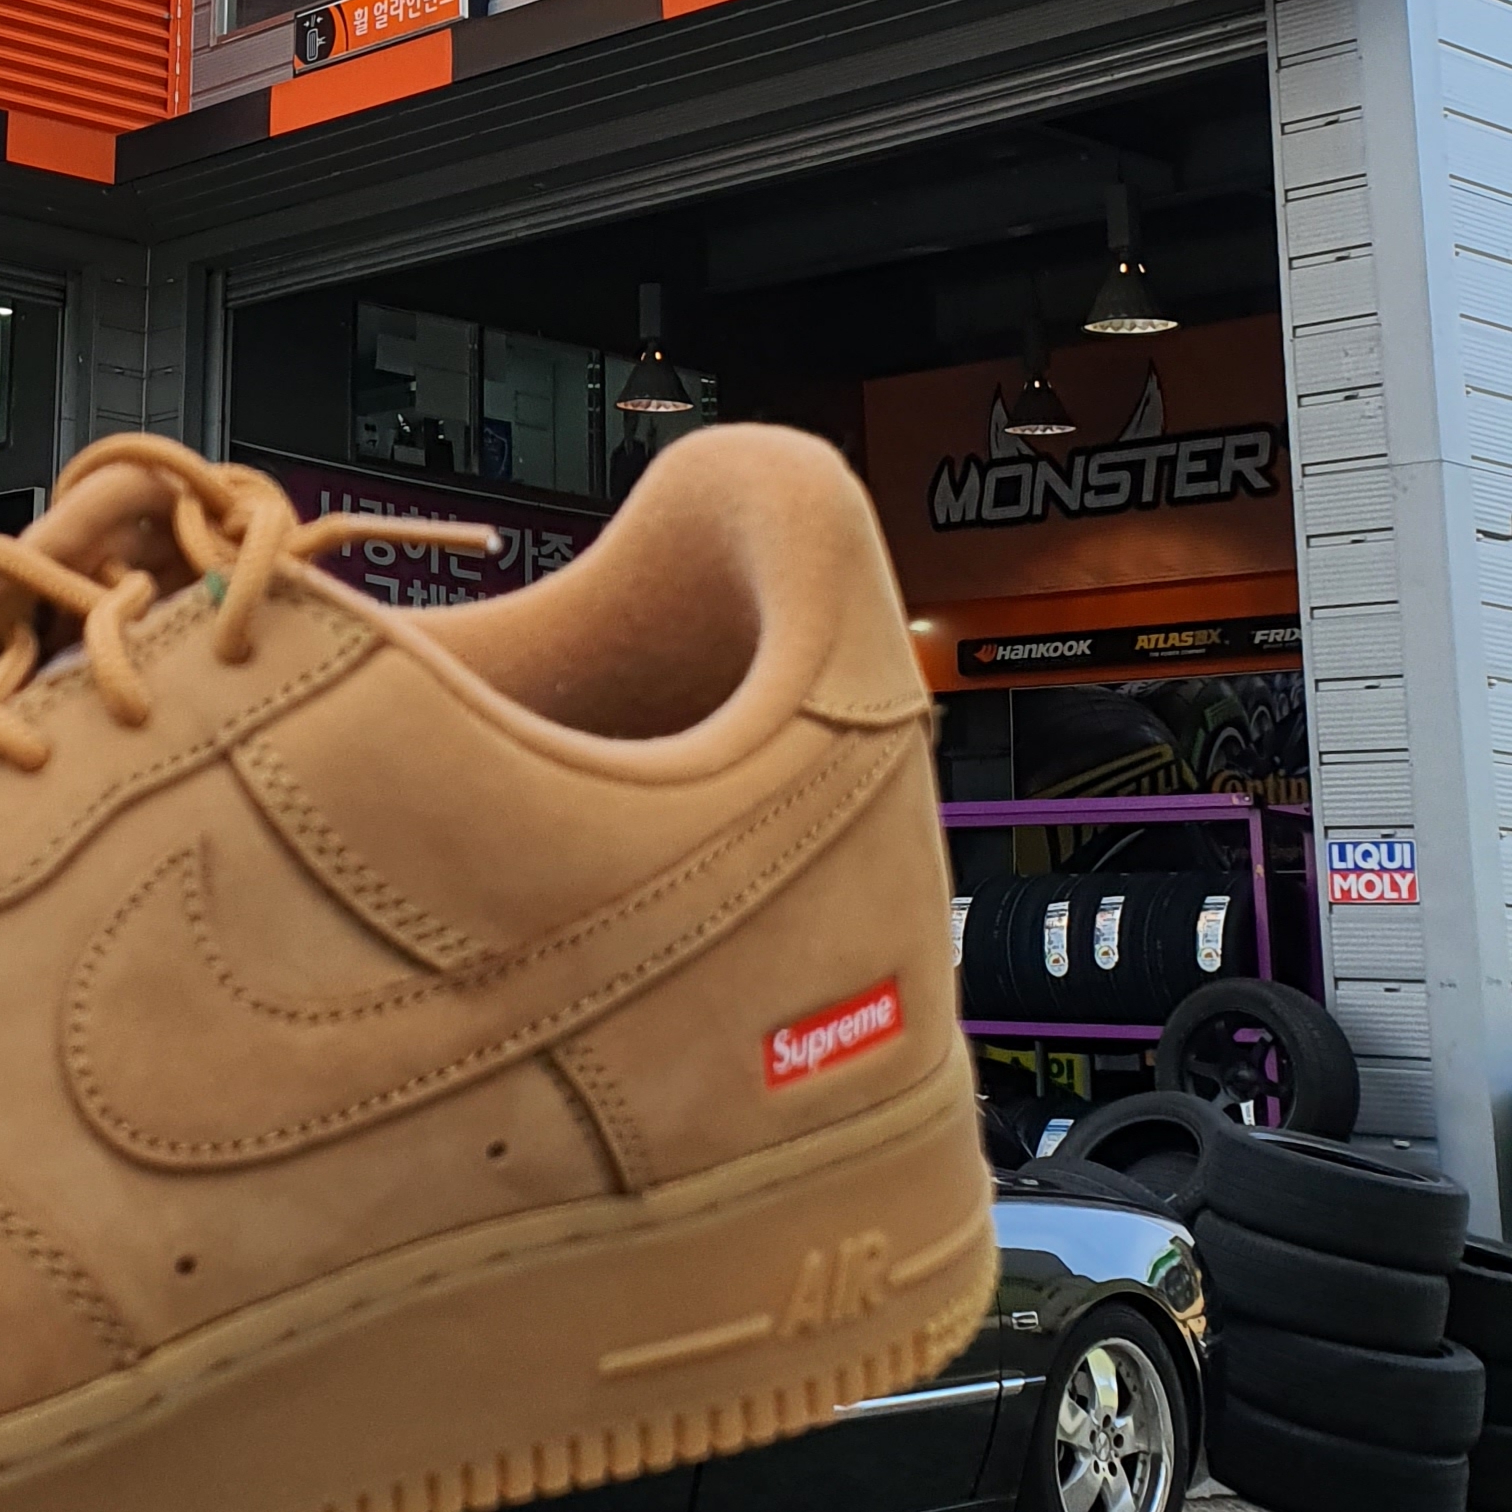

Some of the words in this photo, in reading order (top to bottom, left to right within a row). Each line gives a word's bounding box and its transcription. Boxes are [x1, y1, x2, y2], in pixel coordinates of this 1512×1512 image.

[353, 5, 369, 37] 휠
[932, 428, 1275, 526] MONSTER
[1331, 842, 1413, 871] LIQUI
[1332, 872, 1415, 900] MOLY
[772, 994, 895, 1076] Supreme
[778, 1231, 887, 1338] AIR
